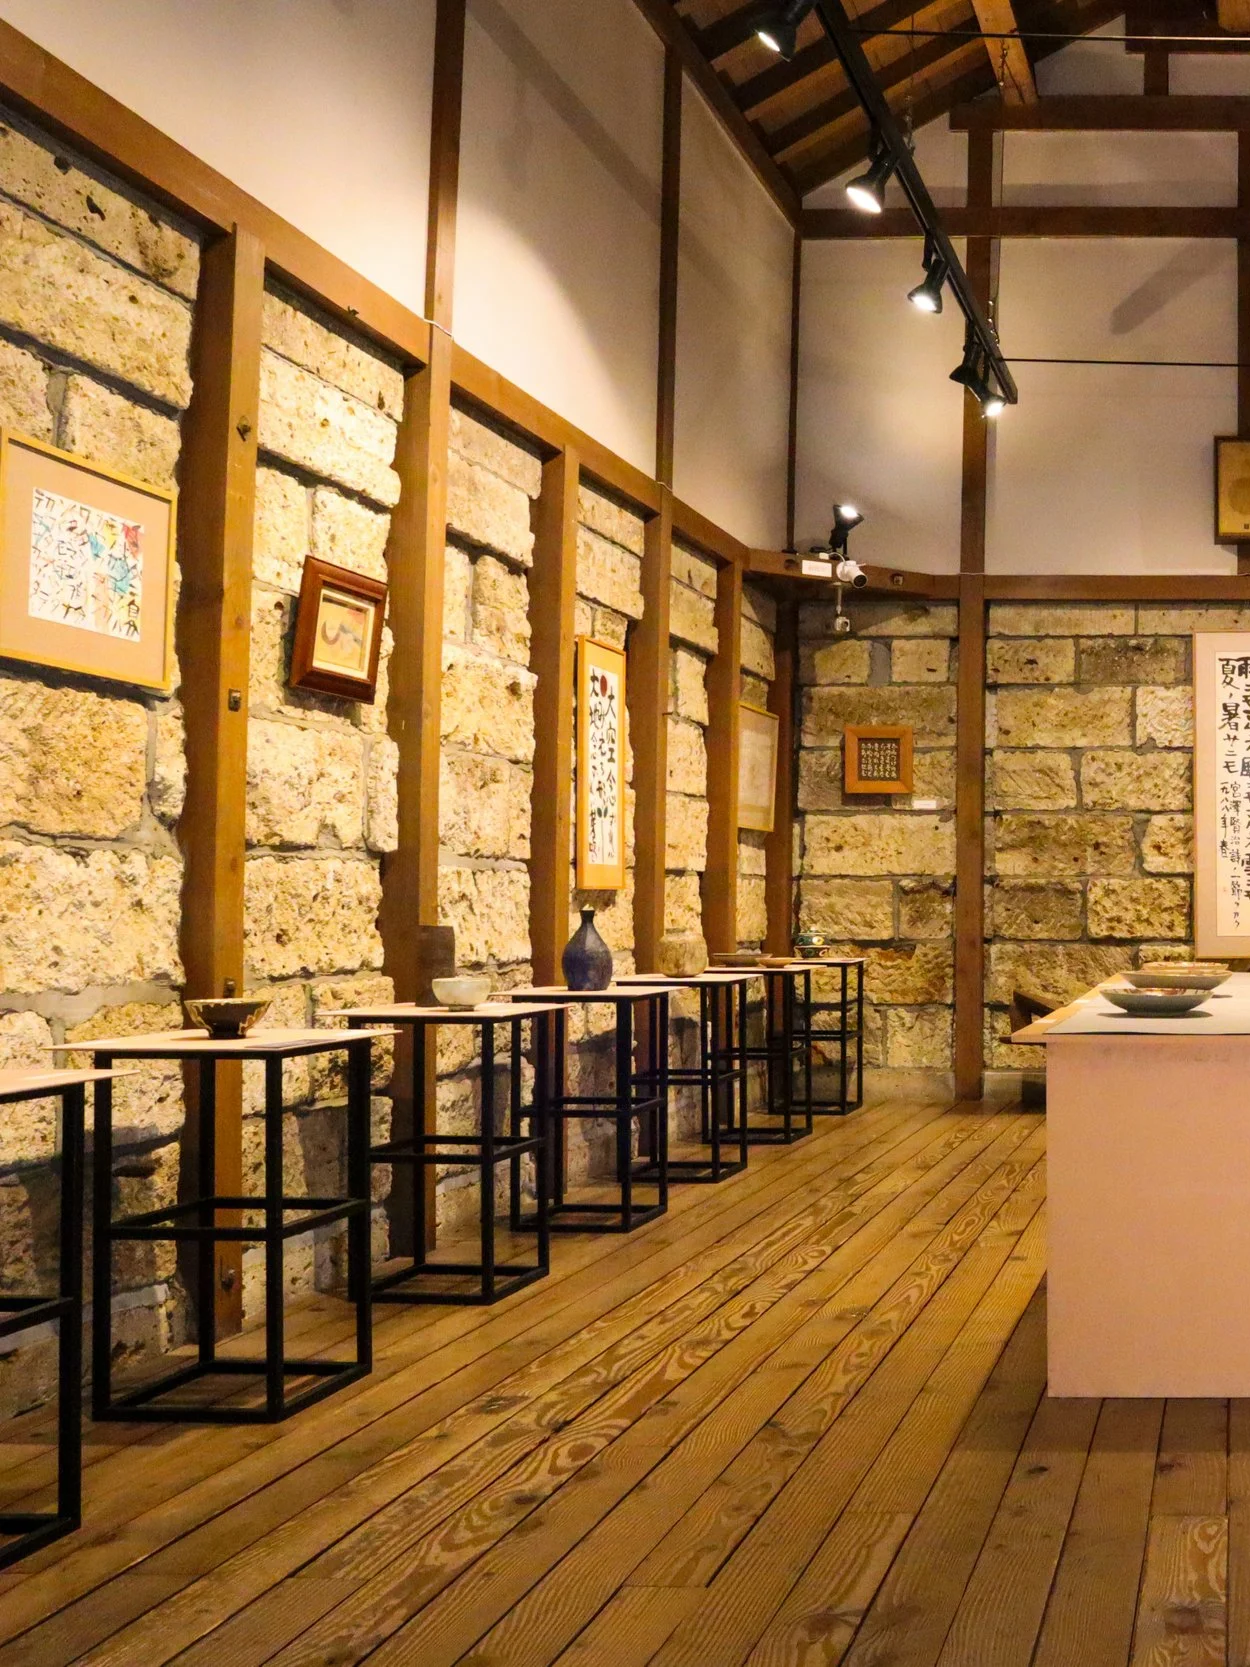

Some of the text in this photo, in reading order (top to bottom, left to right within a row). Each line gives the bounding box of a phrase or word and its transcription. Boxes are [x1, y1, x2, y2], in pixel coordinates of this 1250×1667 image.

[1218, 658, 1240, 774] 夏ノ暑サニモ
